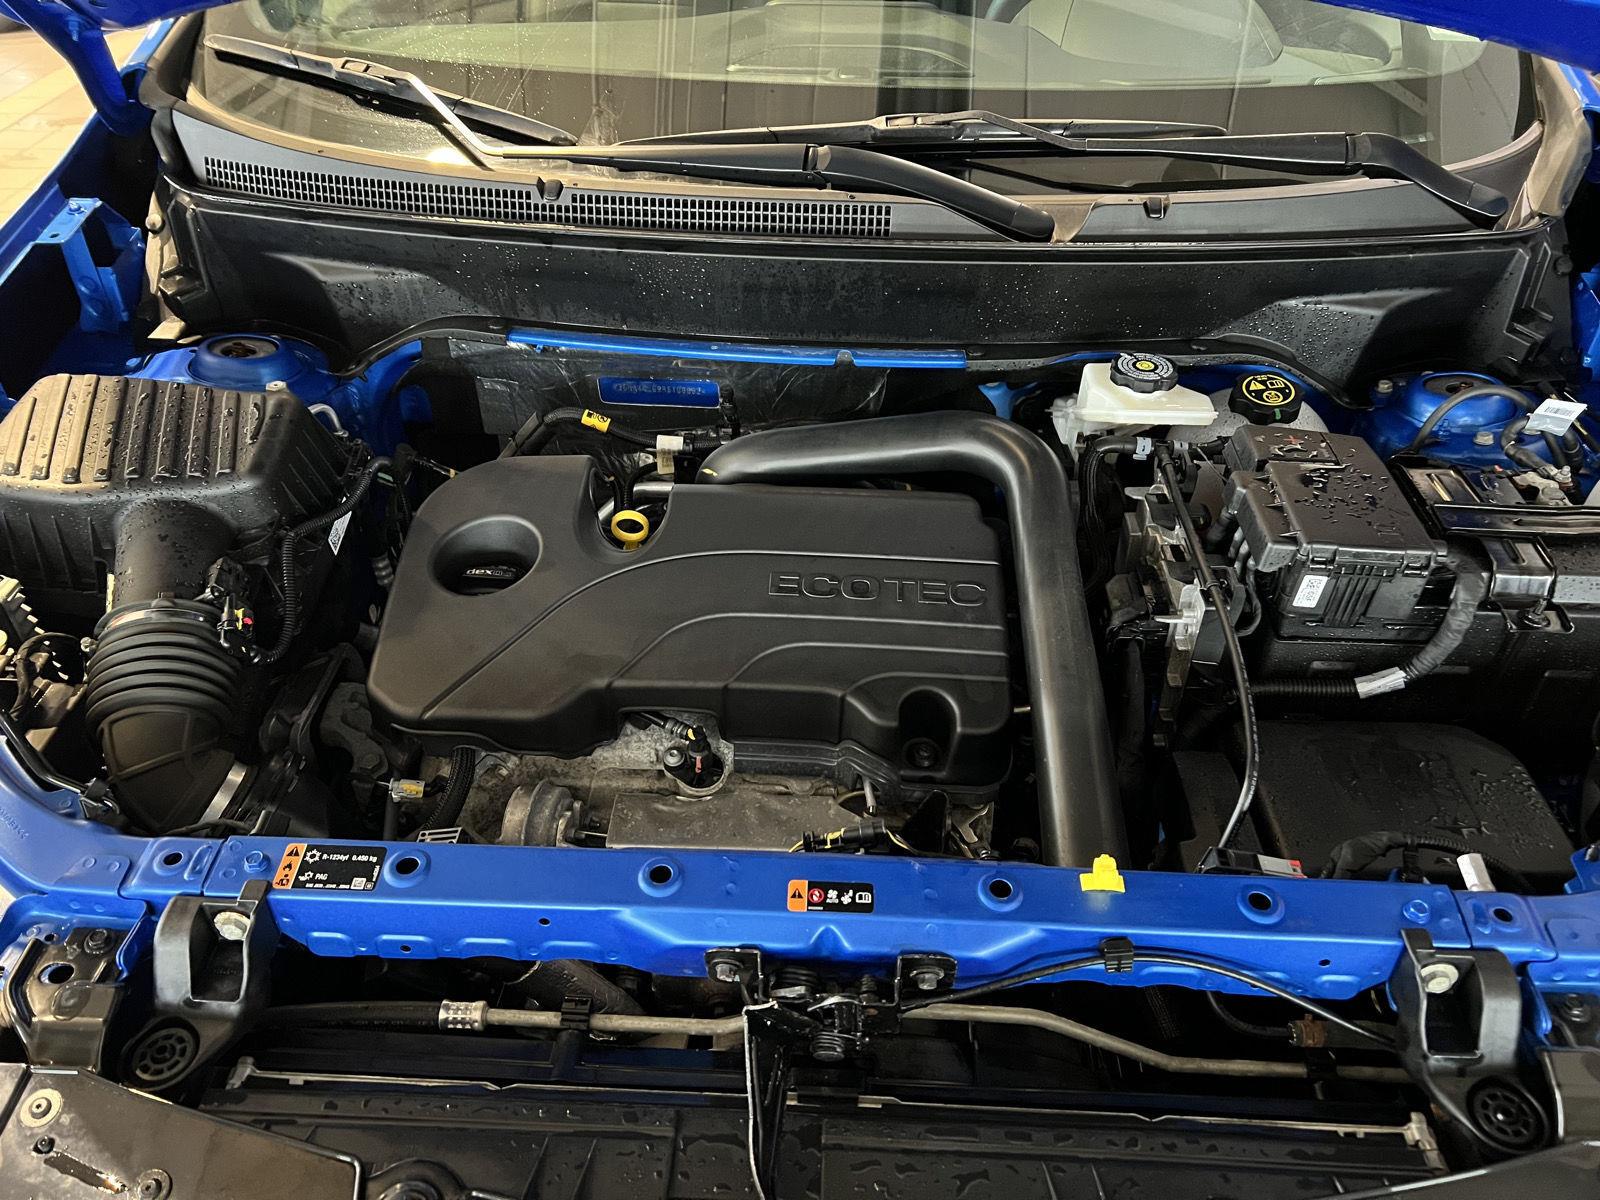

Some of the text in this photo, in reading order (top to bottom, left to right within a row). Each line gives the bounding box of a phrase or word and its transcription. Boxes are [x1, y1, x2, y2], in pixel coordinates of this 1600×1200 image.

[768, 571, 988, 607] ECOTEC
[321, 853, 350, 863] R-1234yf
[368, 855, 378, 863] kg
